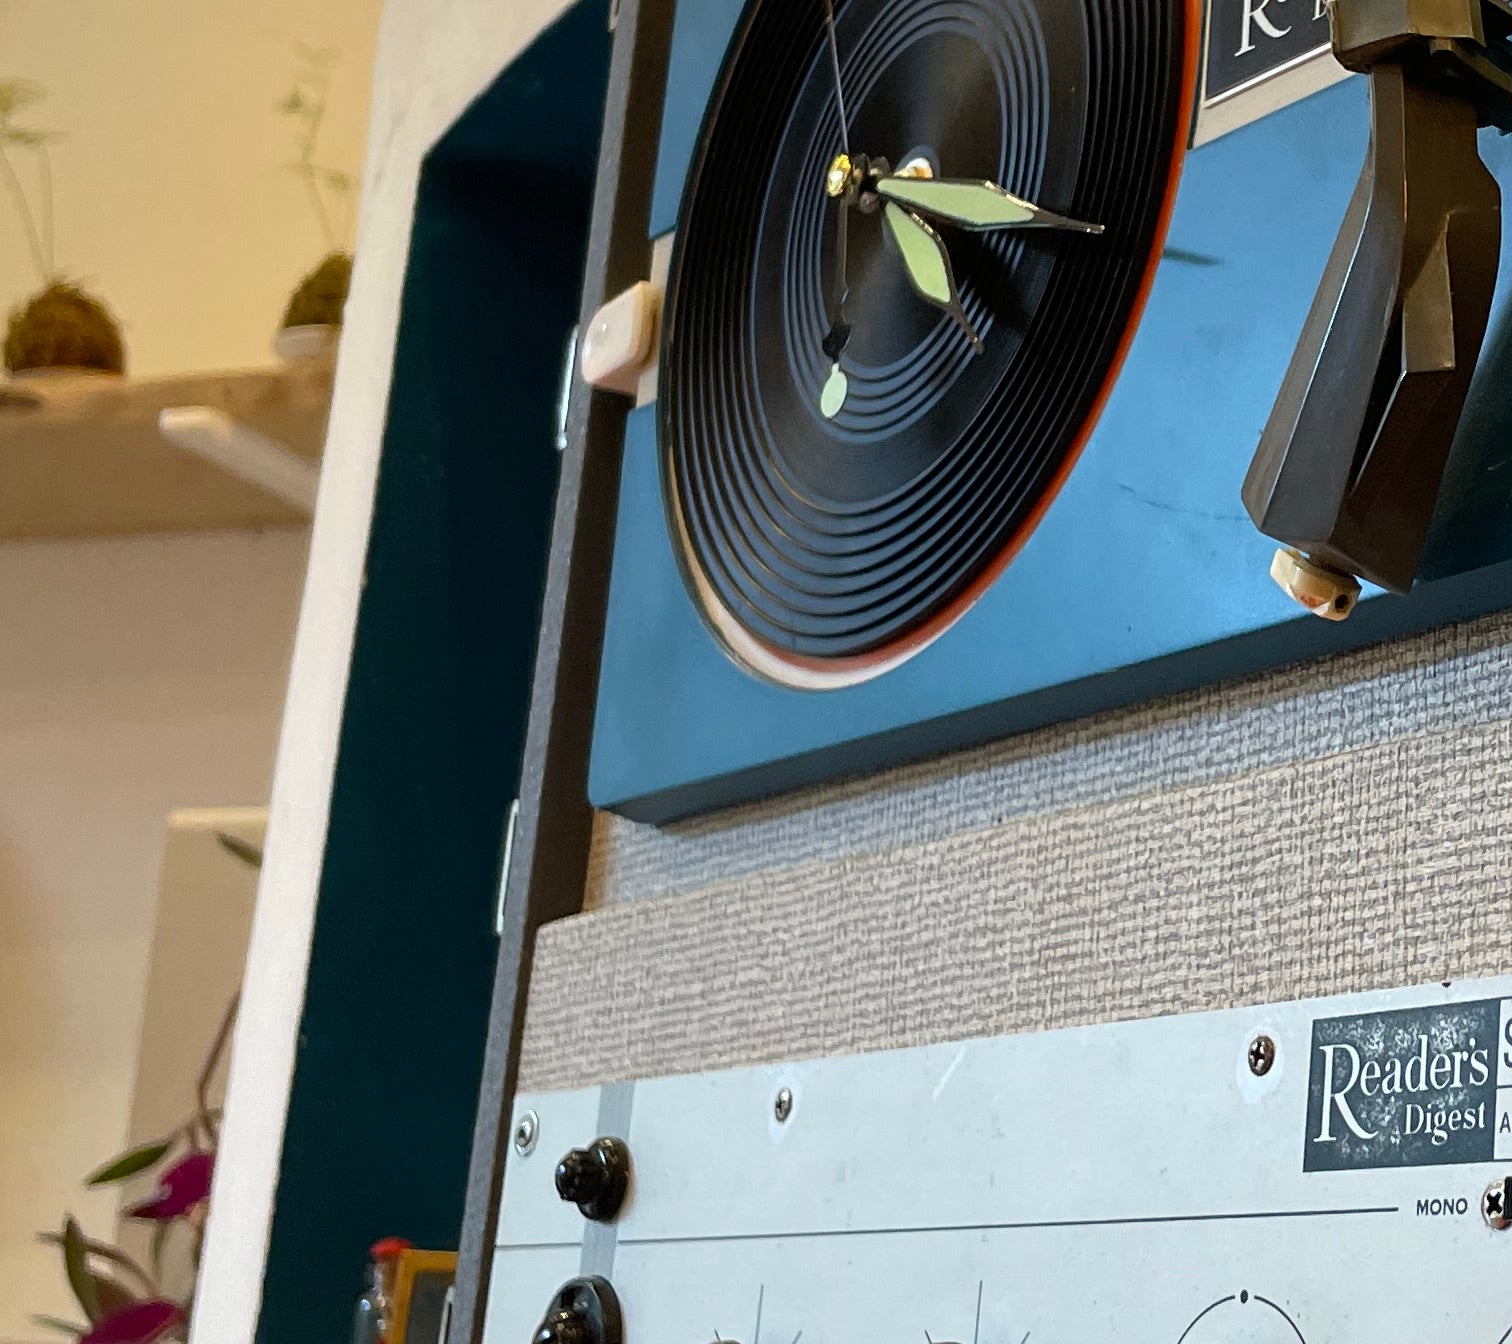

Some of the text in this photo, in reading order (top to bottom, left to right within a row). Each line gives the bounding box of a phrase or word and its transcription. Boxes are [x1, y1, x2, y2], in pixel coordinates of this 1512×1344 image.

[1313, 1034, 1490, 1143] Reader's
[1402, 1101, 1487, 1147] Digest
[1415, 1197, 1469, 1217] MONO
